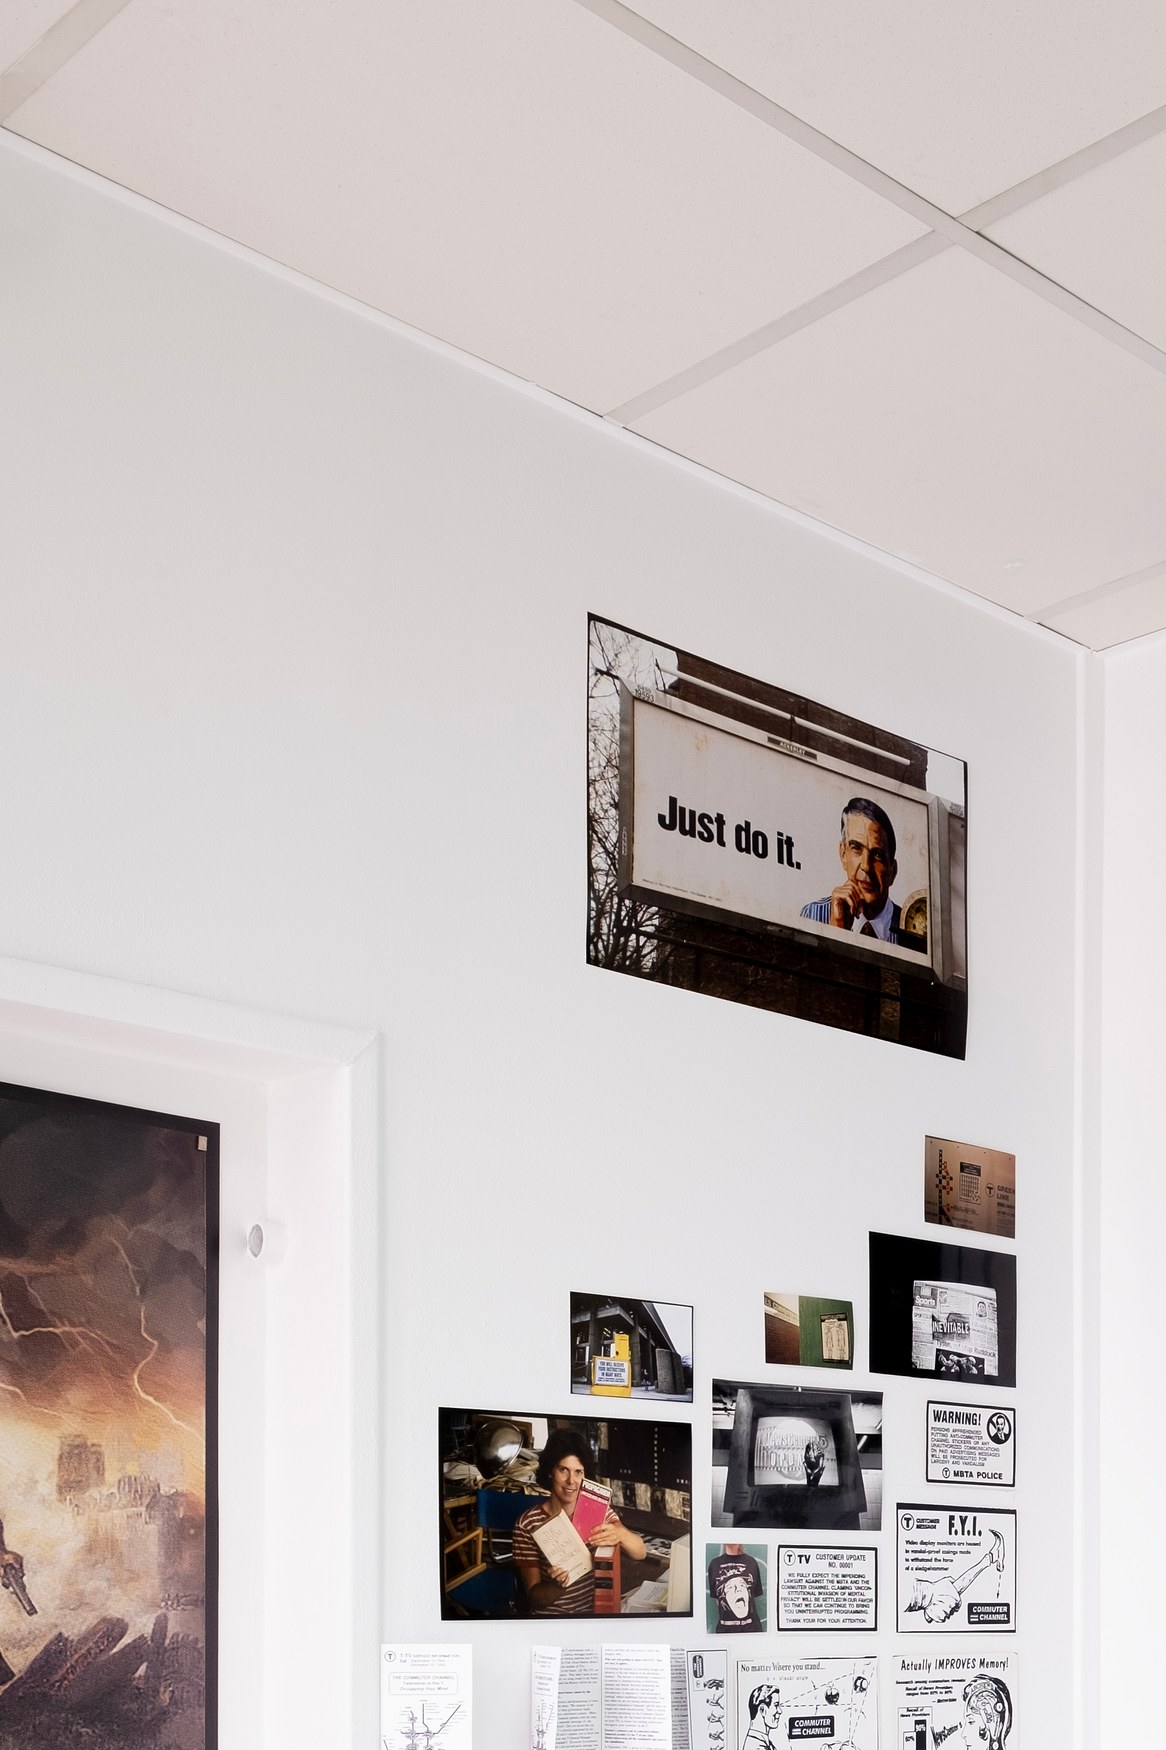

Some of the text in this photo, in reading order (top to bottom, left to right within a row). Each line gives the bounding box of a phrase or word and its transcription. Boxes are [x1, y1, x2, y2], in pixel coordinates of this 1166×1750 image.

[658, 796, 801, 870] Just do it.
[932, 1322, 970, 1334] INEVITABLE
[933, 1410, 981, 1425] WARNING!
[953, 1470, 1003, 1480] MBTA POLICE
[949, 1515, 982, 1536] F.Y.I.
[798, 1555, 810, 1564] TV
[901, 1657, 1008, 1673] Actually IMPROVES Memory!
